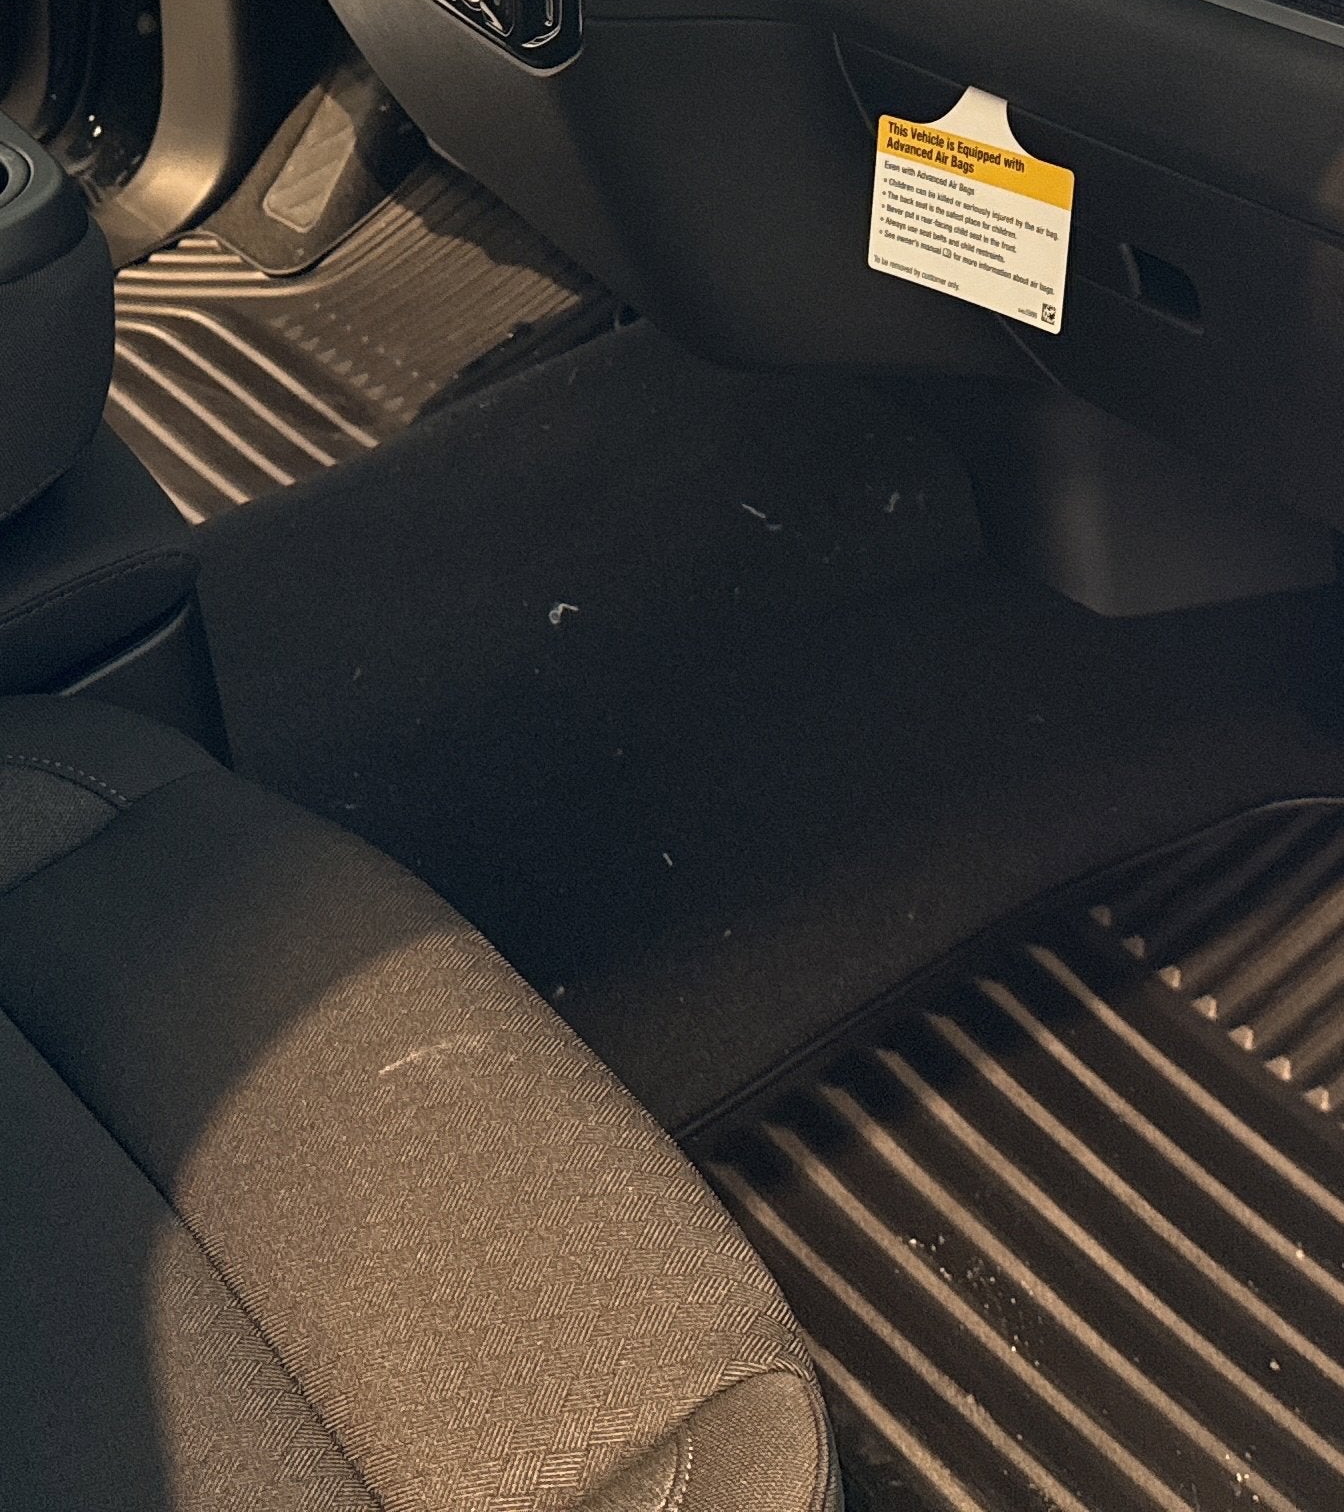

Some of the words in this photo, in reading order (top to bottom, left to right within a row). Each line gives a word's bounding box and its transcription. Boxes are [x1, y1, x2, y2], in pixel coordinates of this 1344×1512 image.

[887, 136, 934, 162] Advanced
[936, 150, 948, 165] Air
[951, 155, 975, 176] Bags
[888, 121, 908, 137] This
[911, 127, 945, 148] Vehicle
[947, 139, 955, 151] is
[957, 141, 1001, 168] Equipped
[1004, 156, 1025, 172] with
[902, 166, 916, 176] with
[917, 170, 947, 186] Advanced
[959, 183, 975, 197] Bags
[889, 178, 915, 192] Children
[938, 193, 954, 204] killed
[963, 201, 990, 218] seriously
[992, 211, 1014, 225] injured
[954, 225, 968, 237] child
[992, 225, 1017, 239] children.
[961, 241, 974, 252] child
[979, 261, 1012, 279] information
[1013, 273, 1029, 285] about
